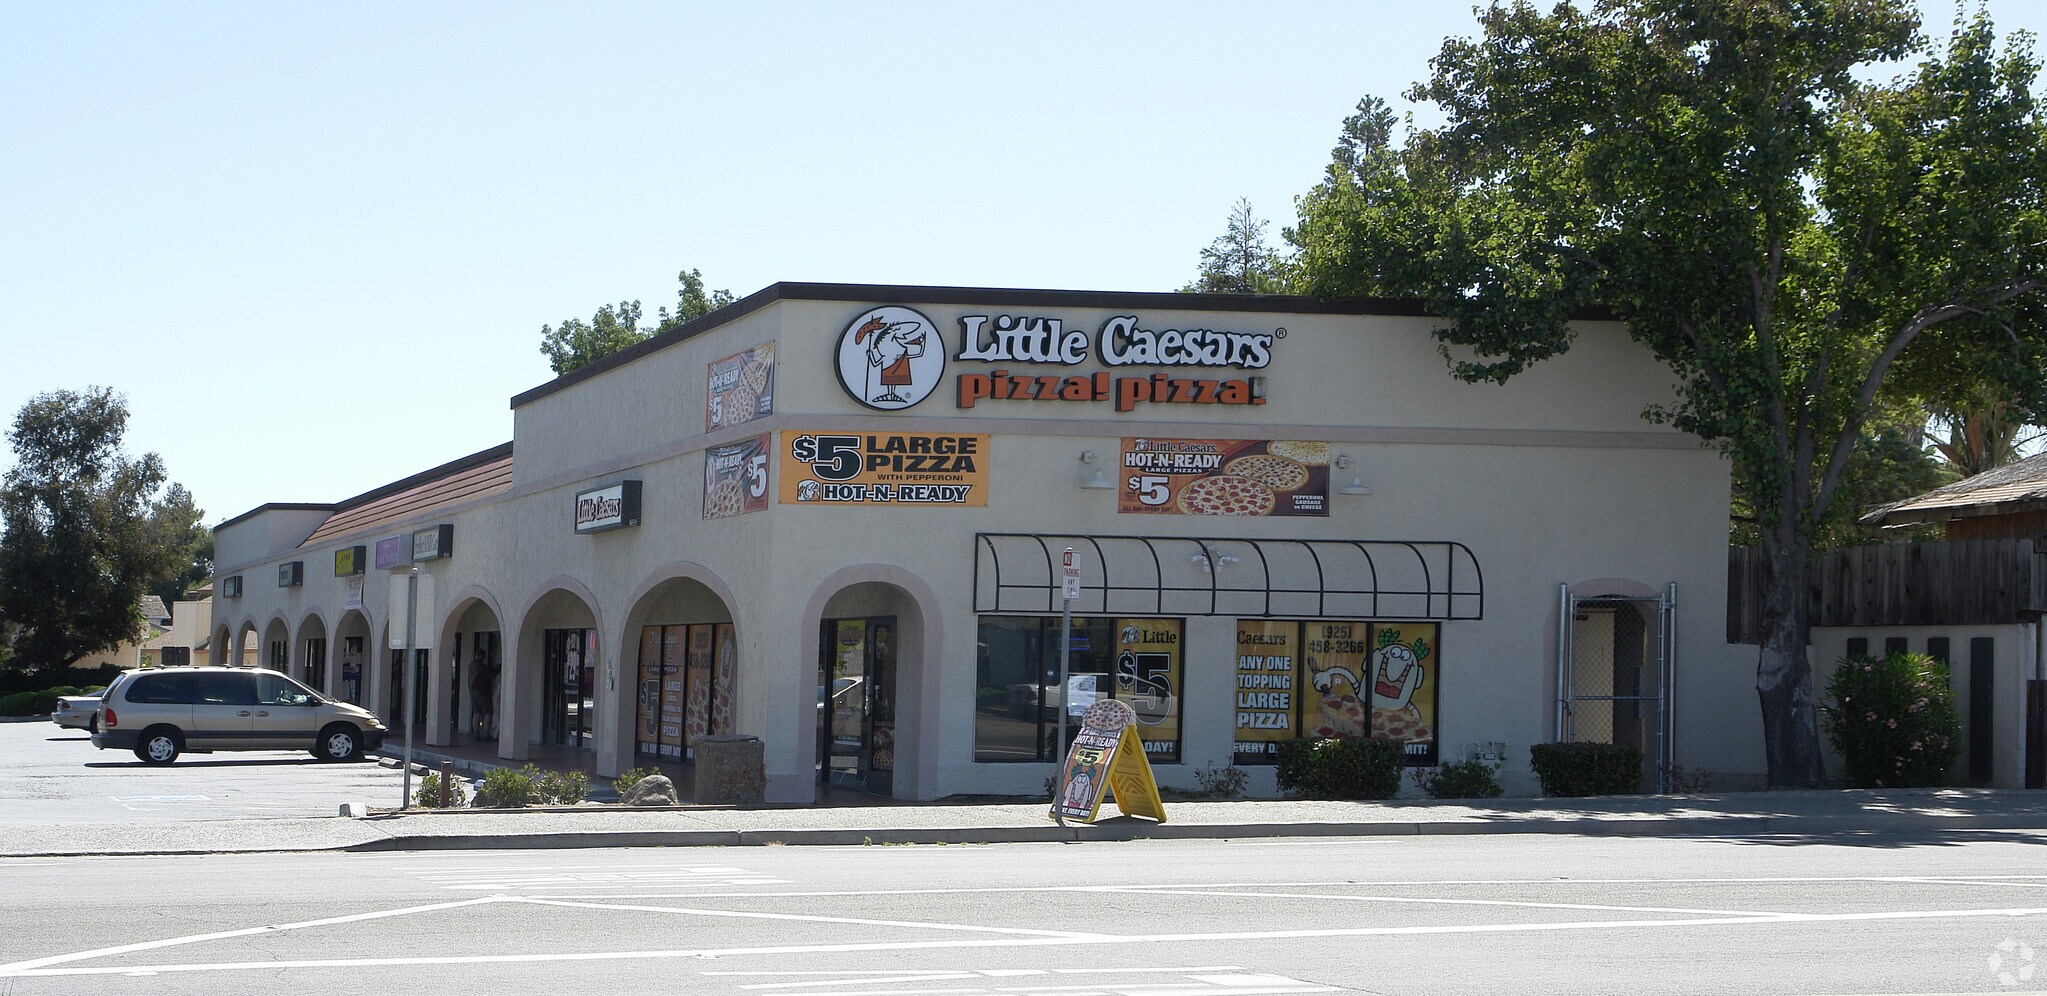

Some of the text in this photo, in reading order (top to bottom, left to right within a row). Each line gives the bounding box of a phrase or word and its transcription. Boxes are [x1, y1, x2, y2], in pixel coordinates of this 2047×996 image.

[954, 314, 1089, 366] Little
[1097, 315, 1273, 370] Caesars
[957, 369, 1266, 412] pizza! pizza!
[709, 396, 722, 423] $5
[867, 436, 978, 454] LARGE
[1150, 441, 1216, 453] Little Caesars
[792, 434, 863, 481] $5
[866, 455, 976, 473] PIZZA
[1125, 452, 1223, 468] HOT-N-READY
[748, 454, 767, 497] $5
[823, 484, 972, 502] HOT-N-READY
[1128, 475, 1171, 506] $5
[577, 495, 621, 524] Little Caesars
[1142, 629, 1177, 644] Little
[1236, 630, 1286, 646] Caesars
[1321, 625, 1352, 639] (925)
[1309, 640, 1364, 653] 458-3266
[1239, 656, 1292, 671] ANY ONE
[664, 681, 682, 692] LARGE
[1117, 649, 1172, 725] $5
[1238, 674, 1291, 690] TOPPING
[641, 679, 659, 737] $5
[1238, 692, 1289, 709] LARGE
[1237, 712, 1289, 730] PIZZA
[663, 726, 679, 737] PIZZA
[1074, 735, 1119, 748] HOT-N-READY
[1145, 741, 1173, 753] DAY!
[1234, 742, 1265, 753] EVERY
[660, 744, 673, 756] EVERY
[1079, 750, 1099, 764] $5
